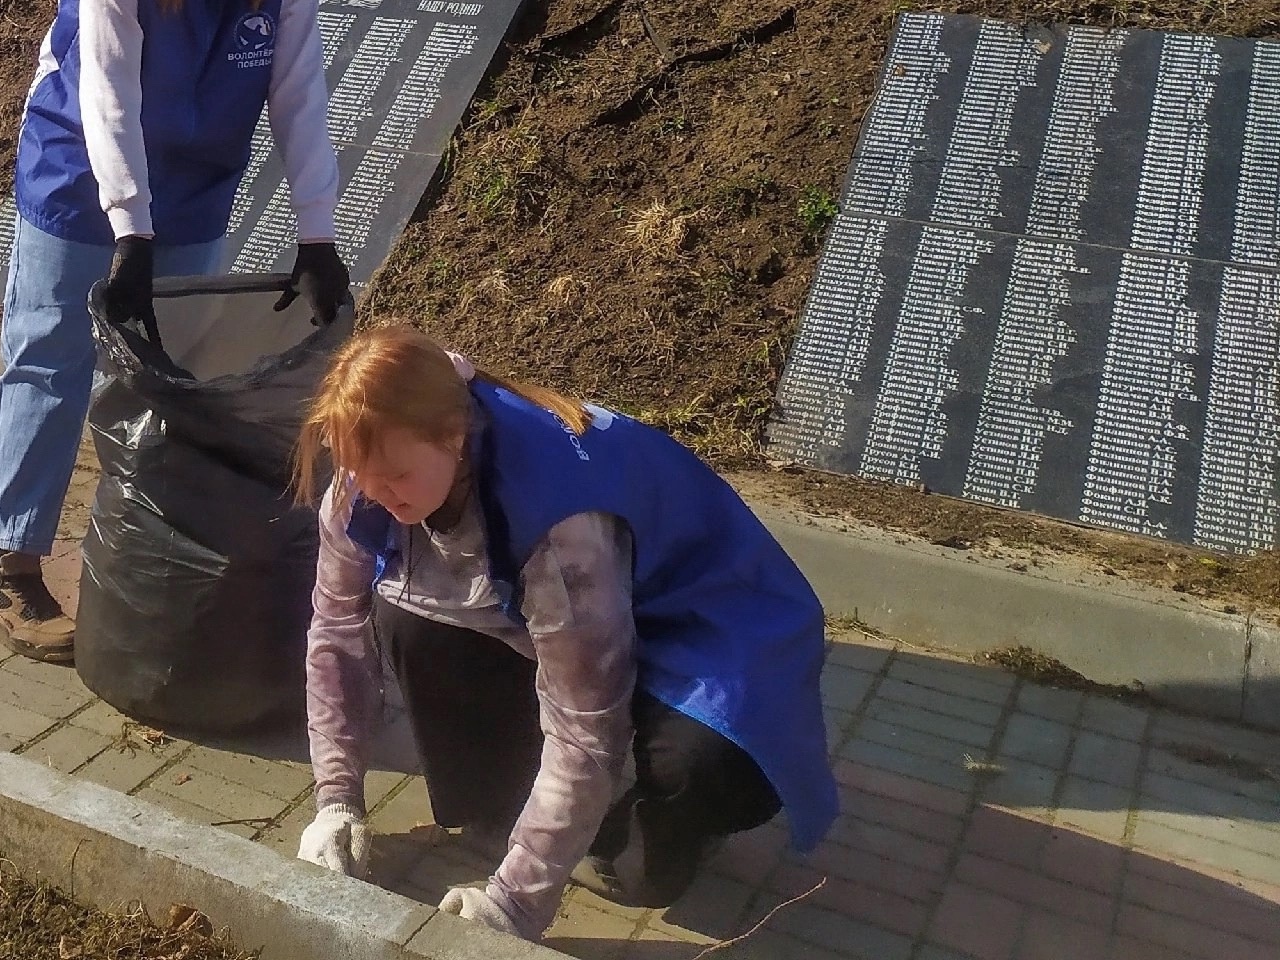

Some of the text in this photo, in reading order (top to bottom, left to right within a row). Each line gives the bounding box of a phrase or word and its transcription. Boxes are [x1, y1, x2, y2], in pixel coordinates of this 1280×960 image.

[417, 0, 484, 17] НАШУ РОДИНУ
[875, 401, 925, 415] Трофимов
[873, 408, 924, 423] Трофимов
[871, 416, 922, 430] Трофимов
[869, 423, 920, 438] Трофимов
[867, 431, 918, 446] Трофимов
[860, 453, 895, 465] Трусов
[864, 446, 897, 458] Трусов
[859, 461, 893, 474] Трусов
